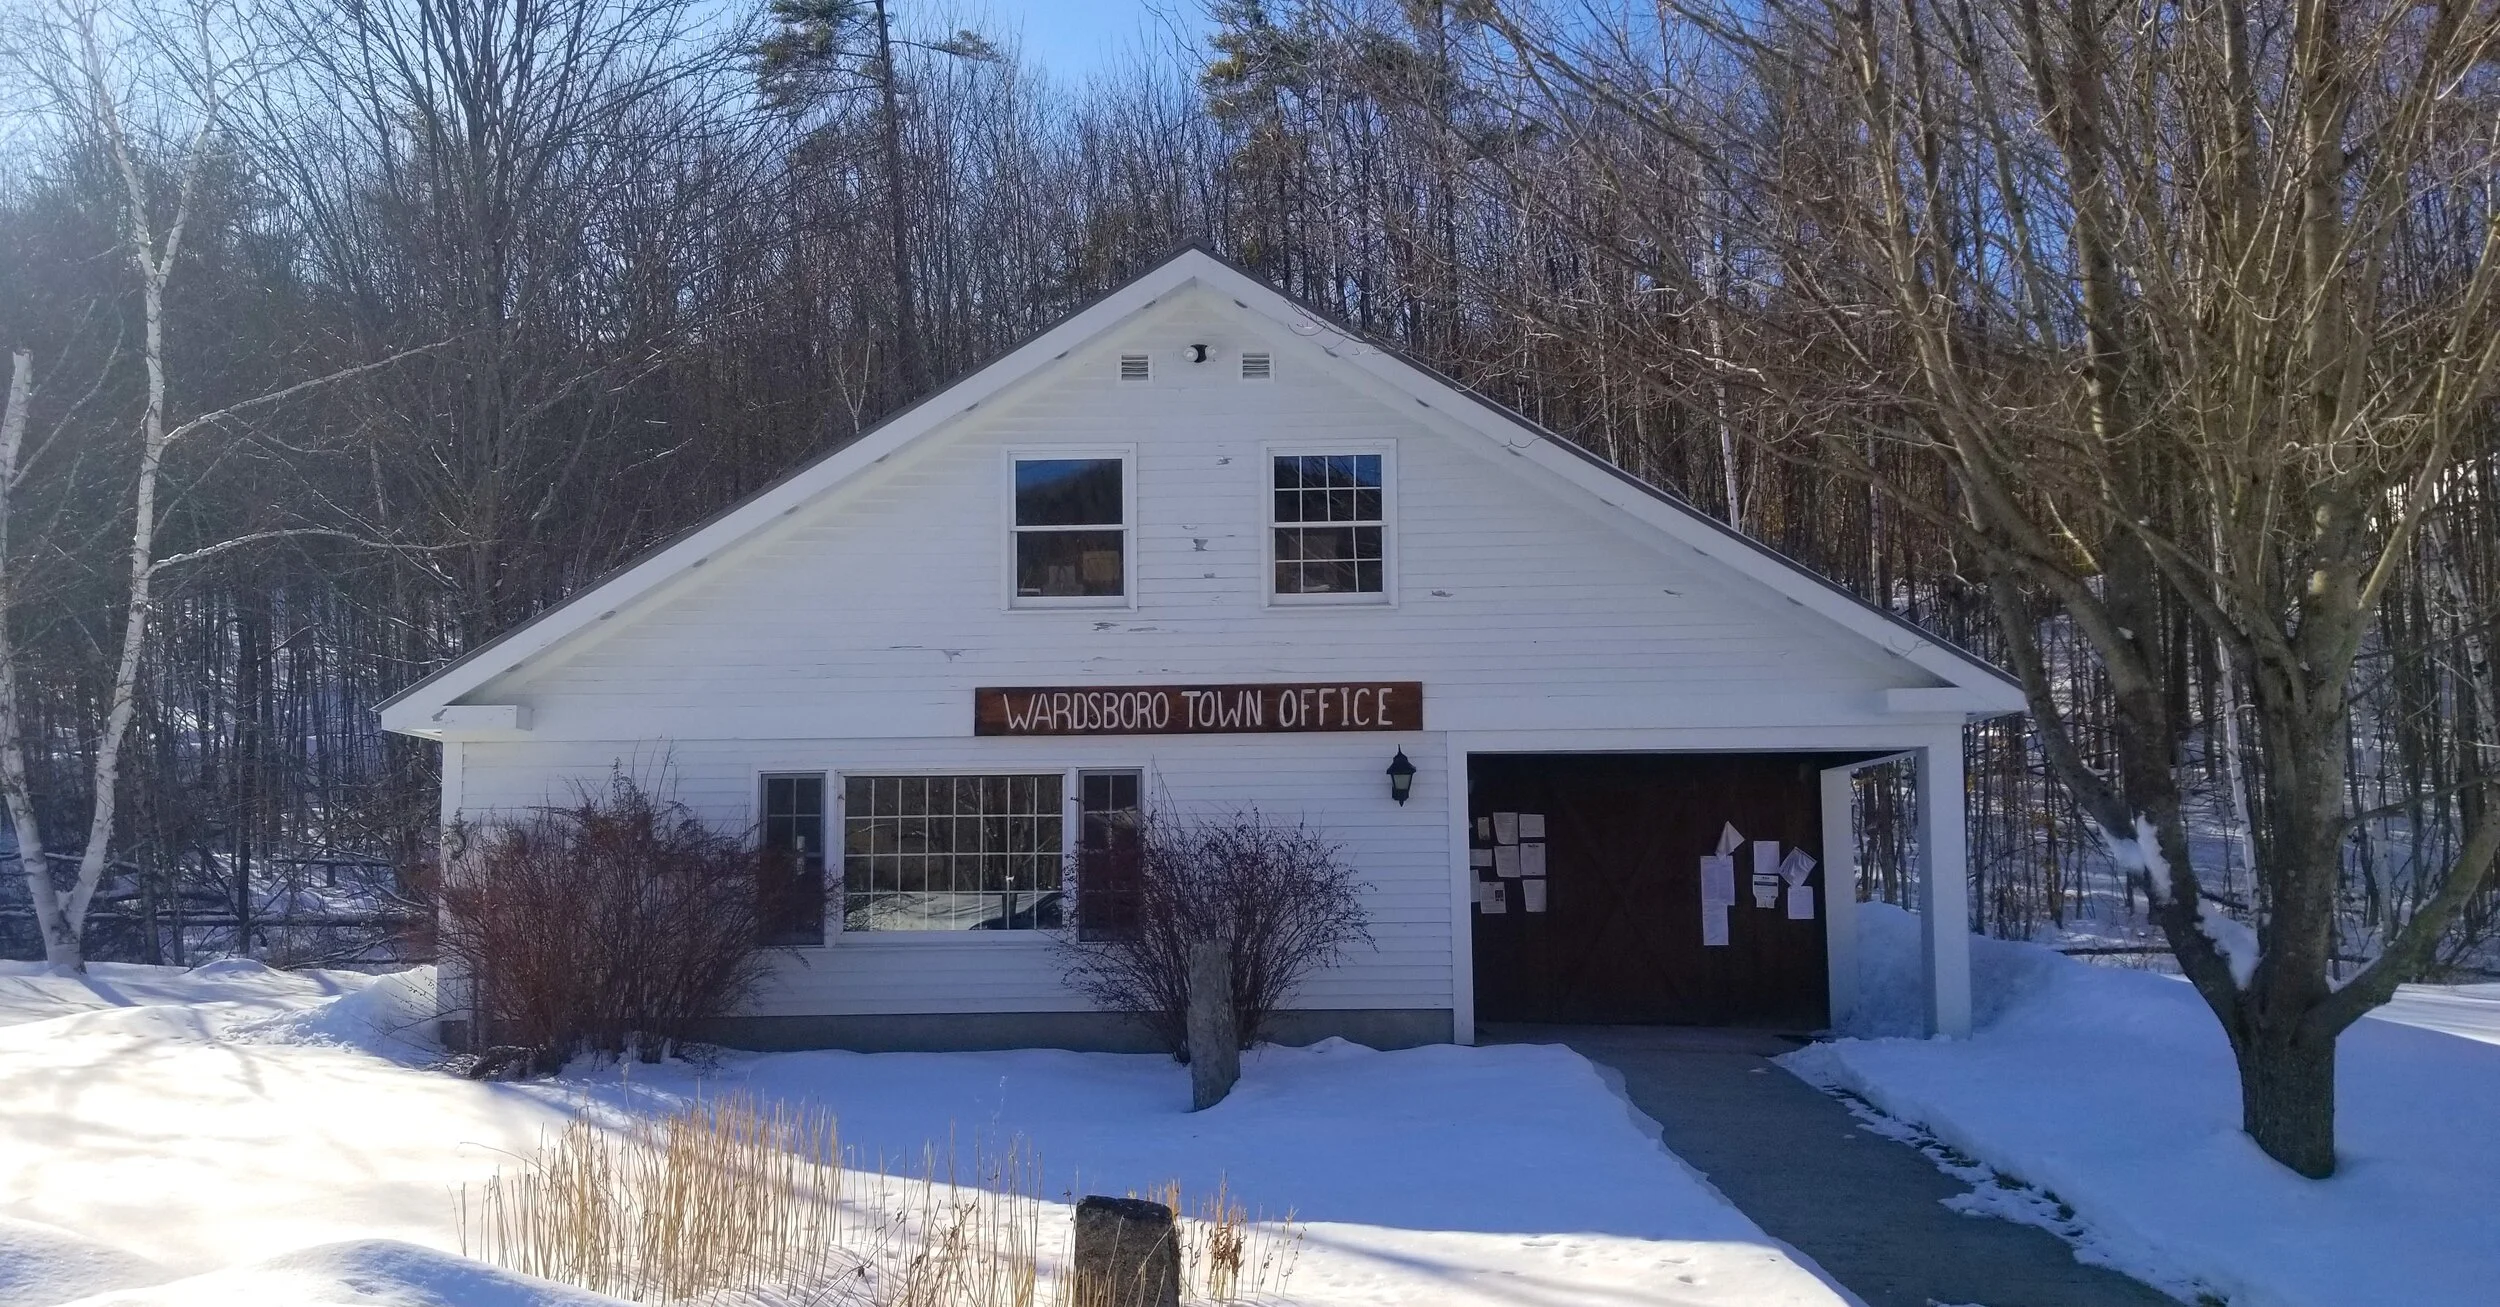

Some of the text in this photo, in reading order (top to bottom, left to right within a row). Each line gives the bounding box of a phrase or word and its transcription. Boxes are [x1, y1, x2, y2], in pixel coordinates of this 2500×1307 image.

[1002, 687, 1393, 730] WARDSBORO TOWN OFFICE
